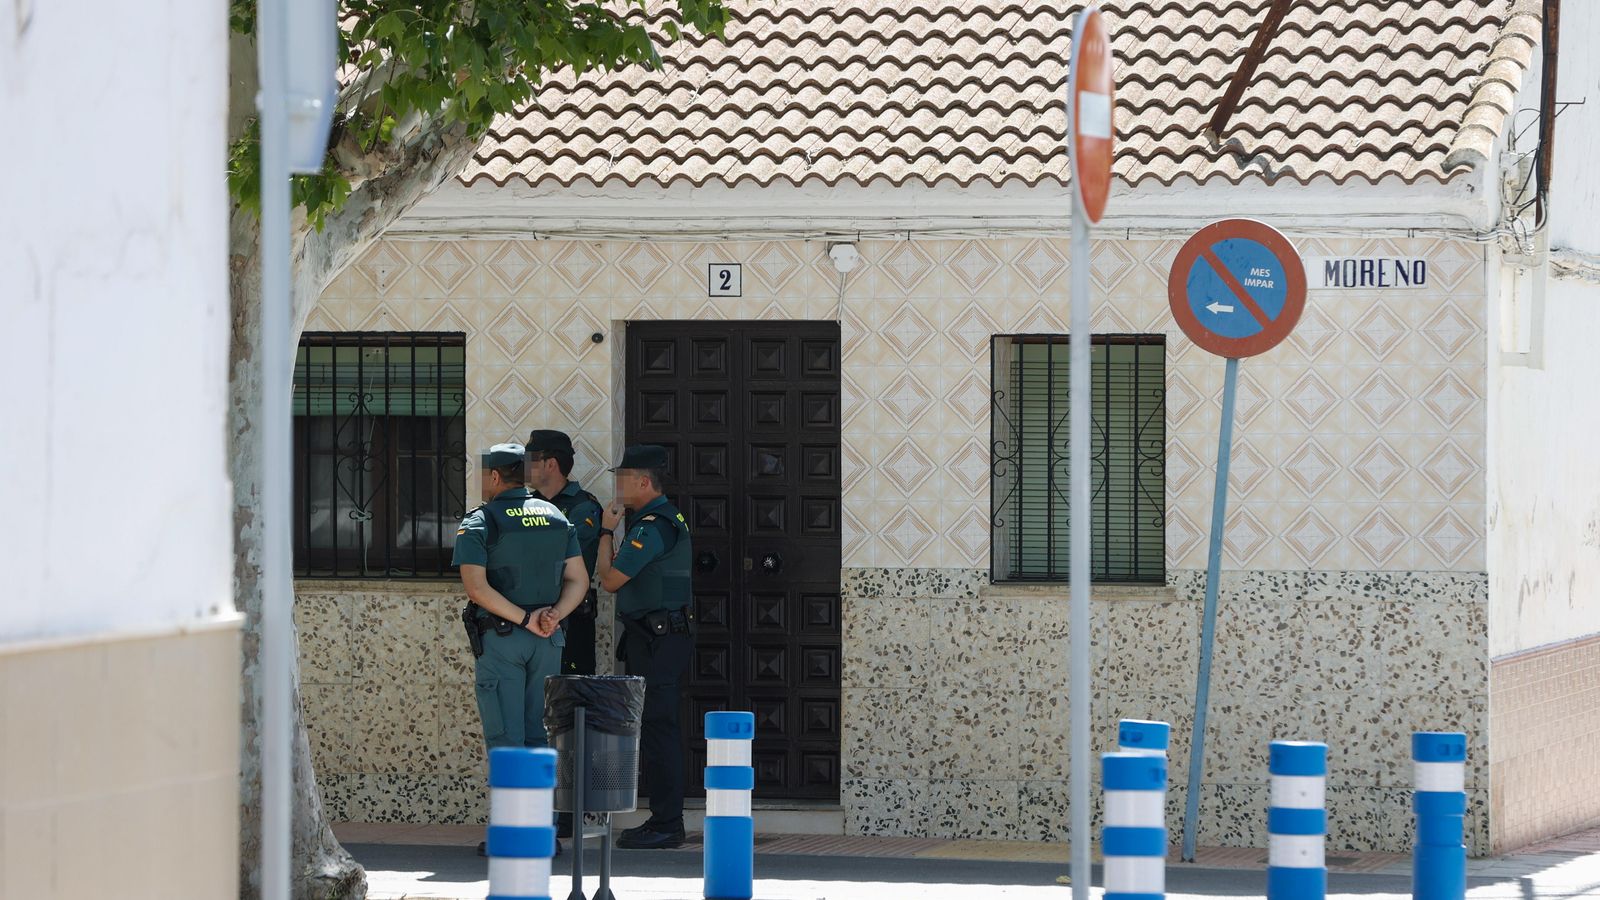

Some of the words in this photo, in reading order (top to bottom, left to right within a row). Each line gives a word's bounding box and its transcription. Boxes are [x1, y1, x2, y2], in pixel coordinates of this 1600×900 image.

[1250, 267, 1271, 278] MES
[1324, 259, 1426, 288] MORENO
[719, 269, 731, 291] 2
[1244, 278, 1274, 289] IMPAR
[506, 506, 554, 517] GUARDIA
[521, 517, 550, 527] CIVIL
